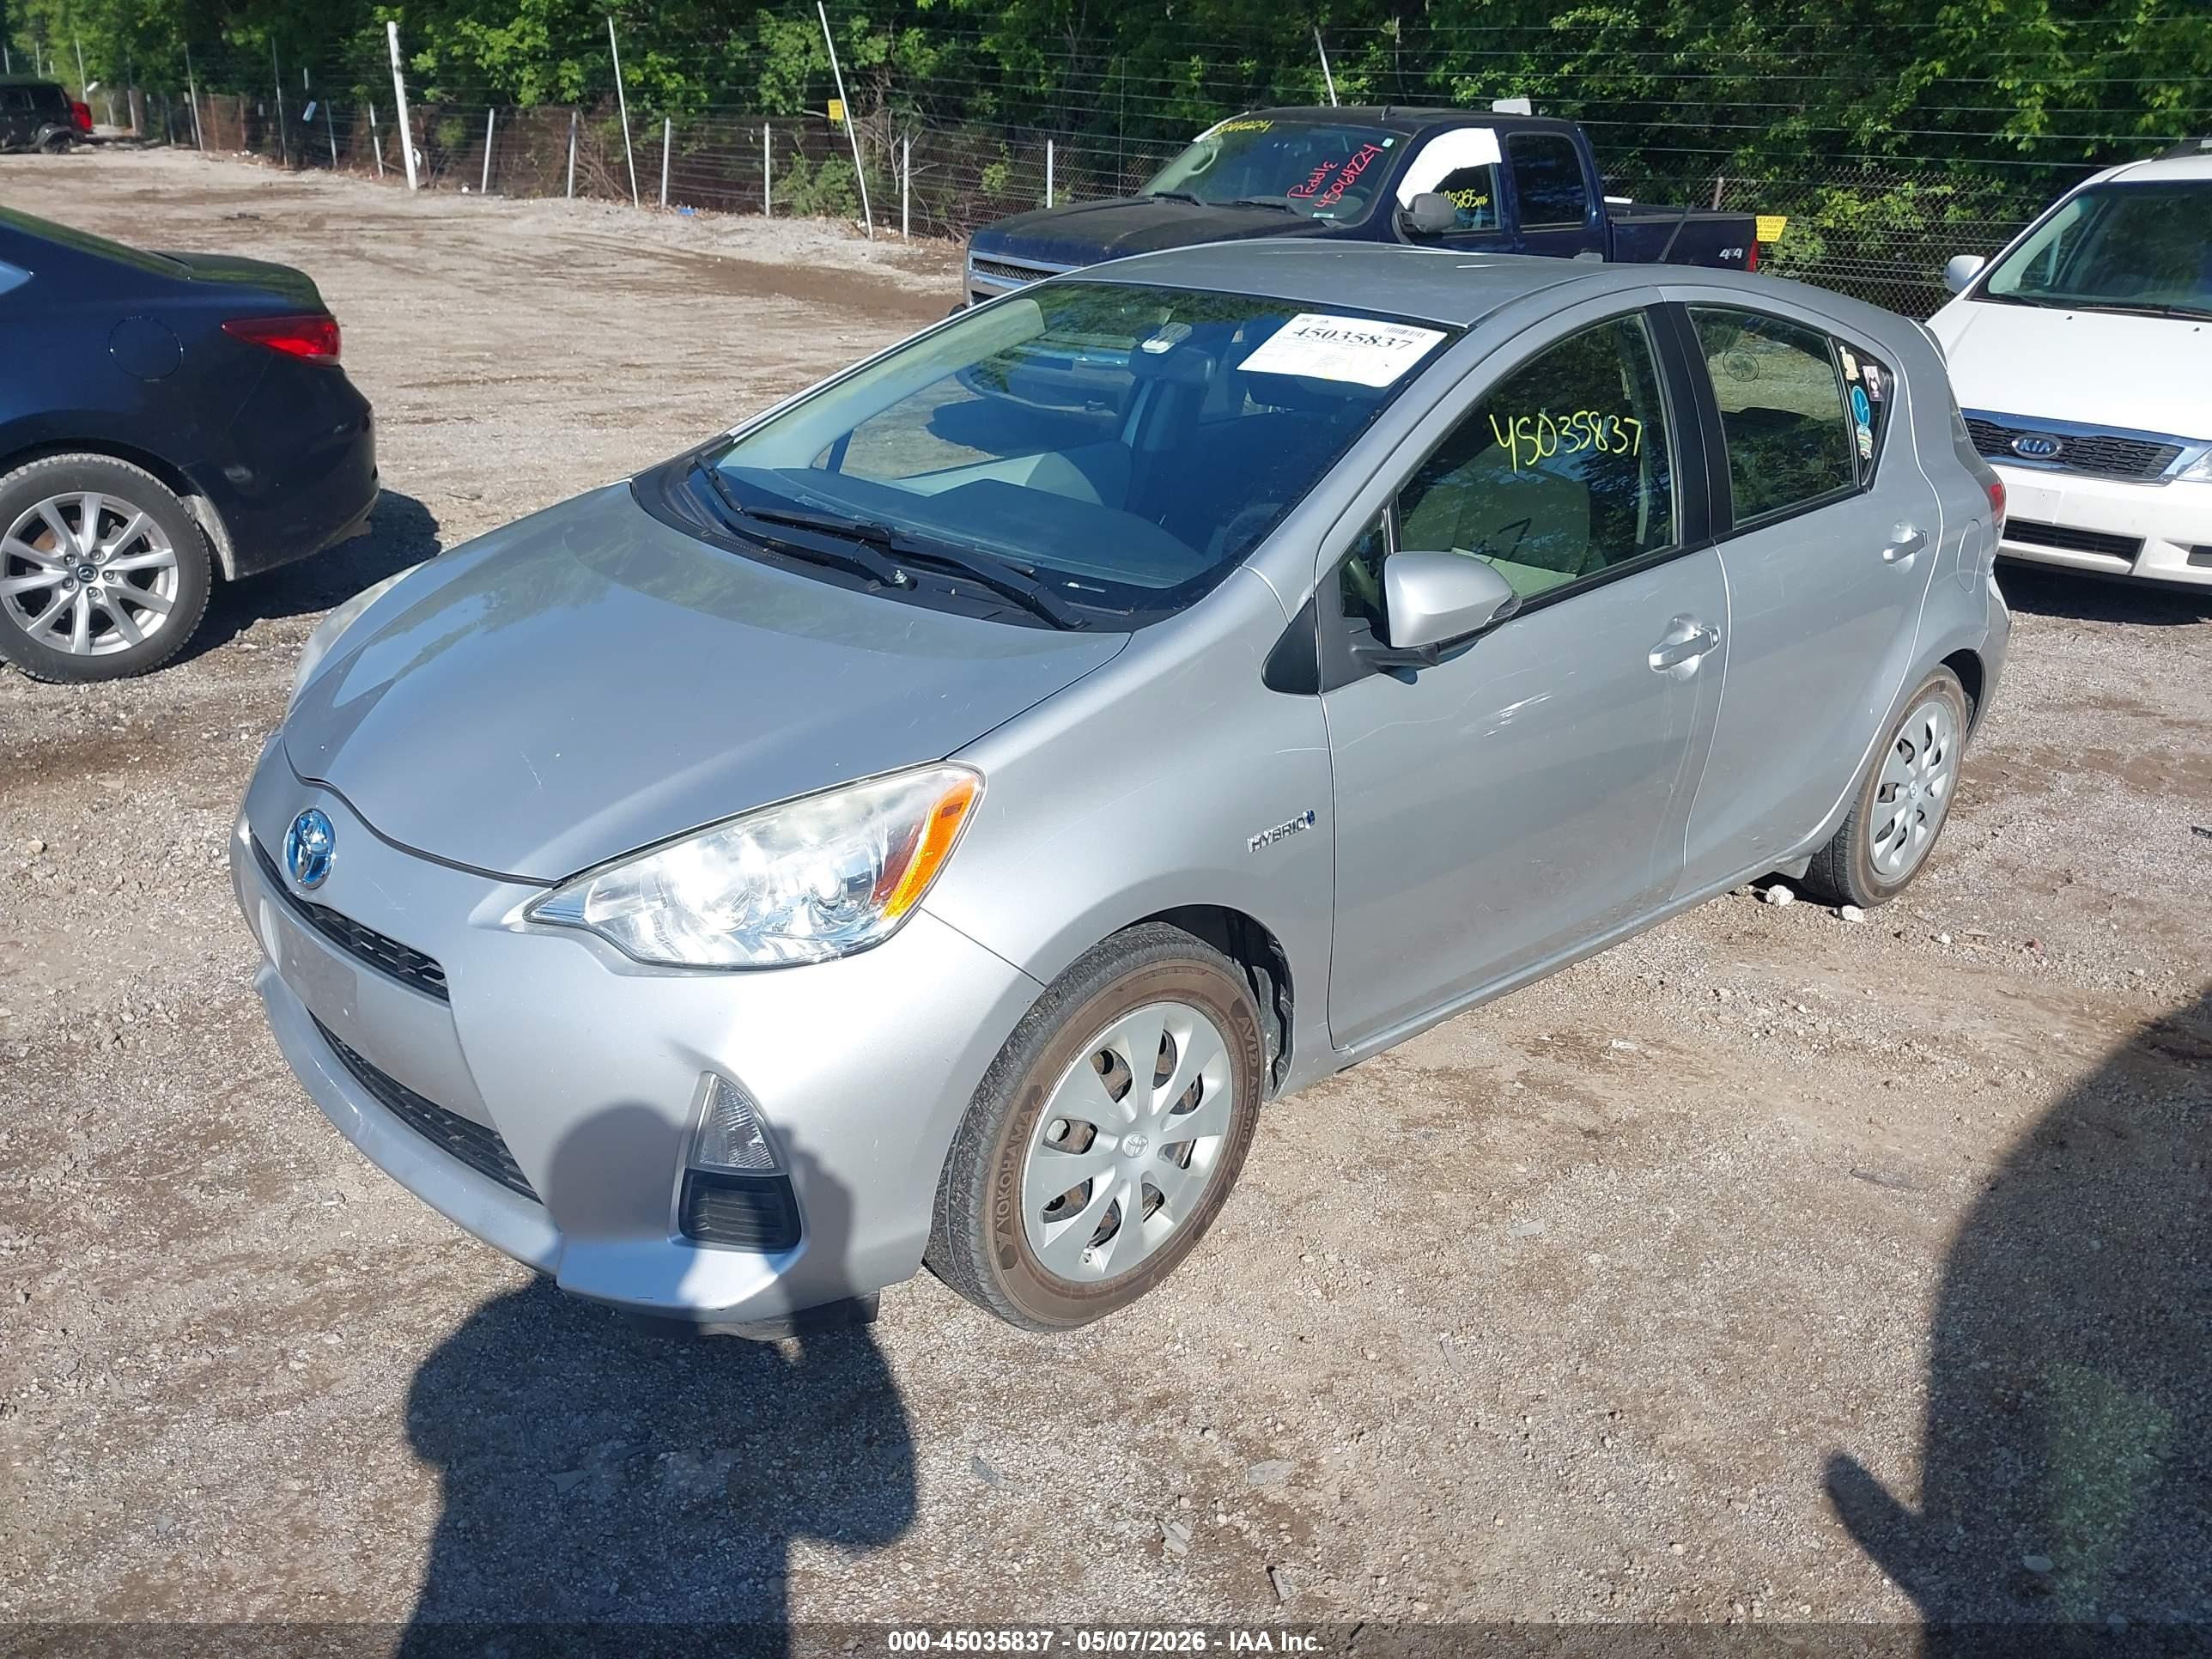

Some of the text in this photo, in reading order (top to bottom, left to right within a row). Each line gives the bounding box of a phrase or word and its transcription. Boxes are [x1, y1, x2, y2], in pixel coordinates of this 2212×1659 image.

[1314, 143, 1384, 209] 45064224
[1292, 326, 1414, 350] 45035837
[1489, 410, 1642, 475] 45035837
[2019, 439, 2051, 453] KIA
[1247, 817, 1306, 853] HYBRID
[996, 1110, 1033, 1229] YOKOHAMA
